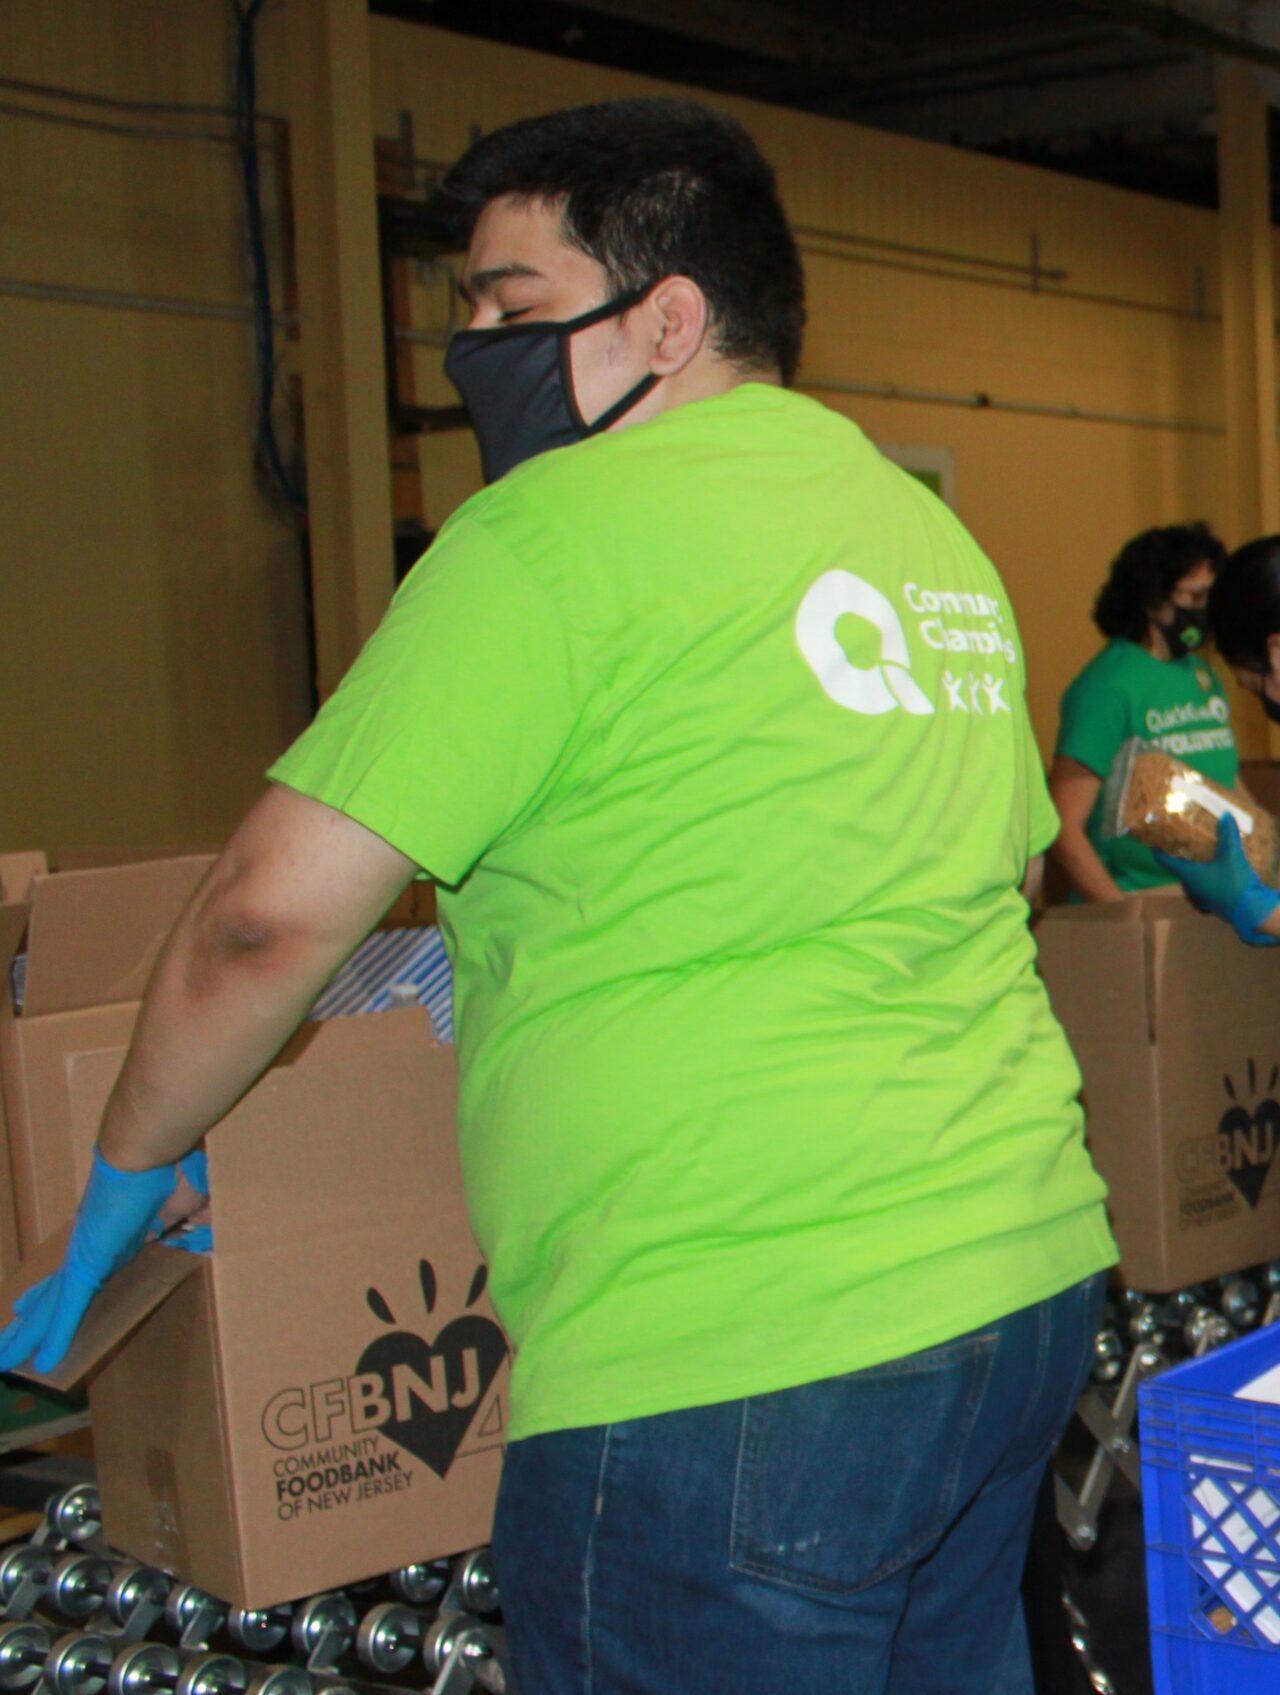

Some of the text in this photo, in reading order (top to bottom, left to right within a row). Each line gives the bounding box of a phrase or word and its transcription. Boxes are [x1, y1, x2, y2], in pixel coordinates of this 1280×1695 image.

[272, 1435, 381, 1479] COMMUNITY
[275, 1451, 402, 1501] FOODBANK
[277, 1469, 414, 1522] OF NEW JERSEY
